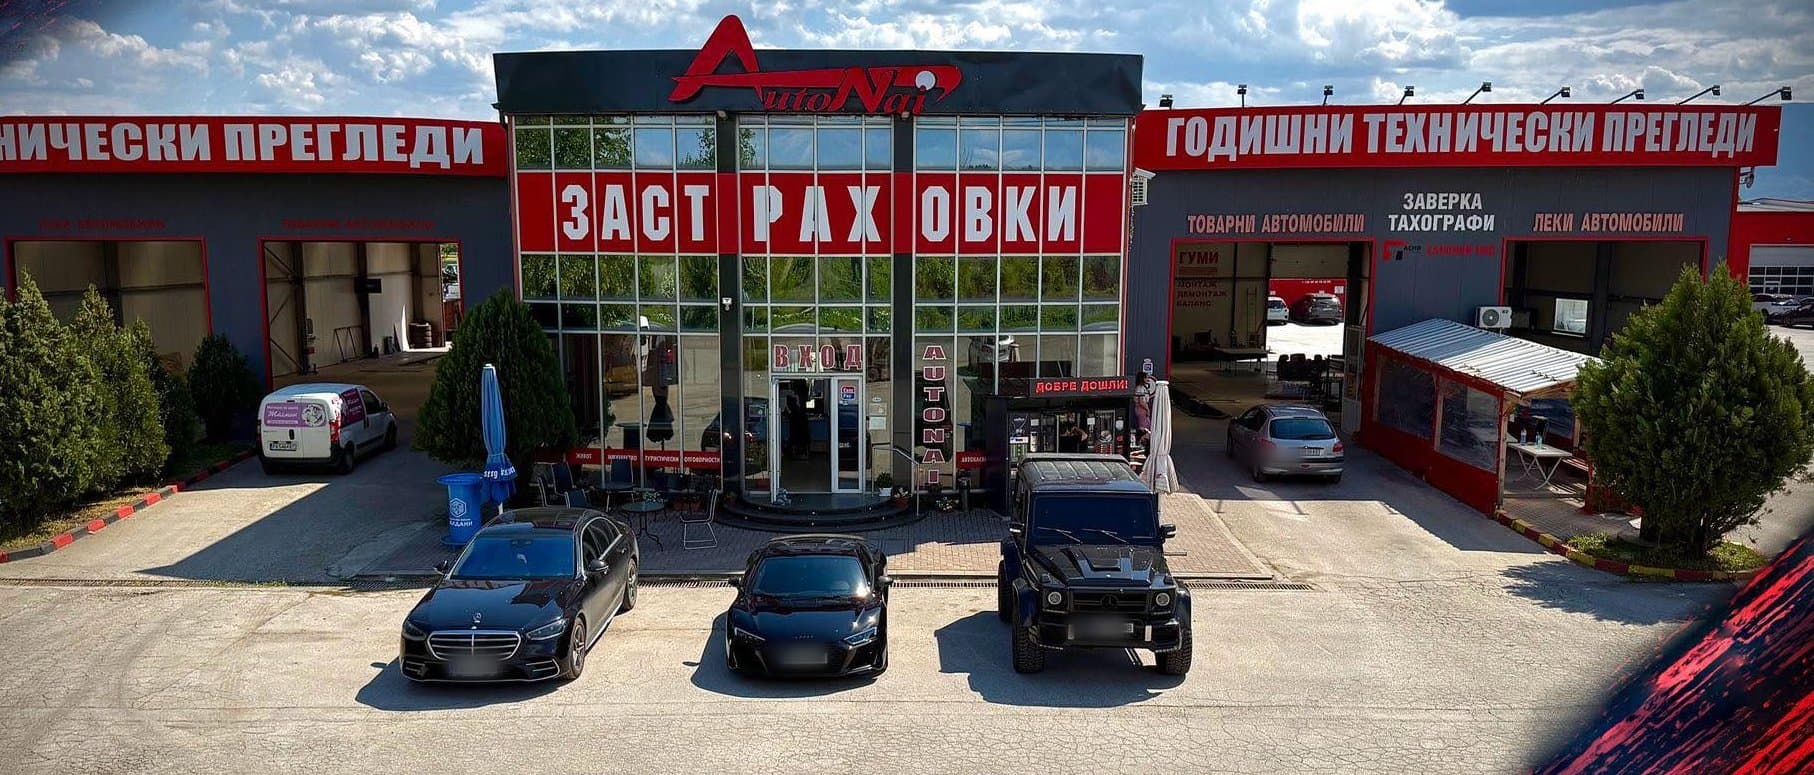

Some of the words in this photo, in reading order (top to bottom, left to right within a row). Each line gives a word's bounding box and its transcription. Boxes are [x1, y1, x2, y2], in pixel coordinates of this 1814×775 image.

[668, 14, 962, 115] AutoNai
[223, 123, 484, 169] ПРЕГЛЕДИ
[1166, 113, 1354, 162] ГОДИШНИ
[1363, 111, 1596, 154] ТЕХНИЧЕСКИ
[1602, 112, 1757, 158] ПРЕГЛЕДИ
[1403, 193, 1483, 210] ЗАВЕРКА
[1187, 215, 1256, 233] ТОВАРНИ
[1261, 213, 1365, 233] АВТОМОБИЛИ
[1388, 214, 1495, 231] ТАХОГРАФИ
[1533, 213, 1574, 232] ЛЕКИ
[1580, 213, 1684, 232] АВТОМОБИЛИ
[1179, 251, 1219, 265] ГУМИ
[773, 344, 863, 370] ВХОД
[1036, 381, 1077, 393] ДОБРЕ
[1080, 380, 1128, 392] ДОШЛИ!
[922, 345, 946, 484] AUTONAI
